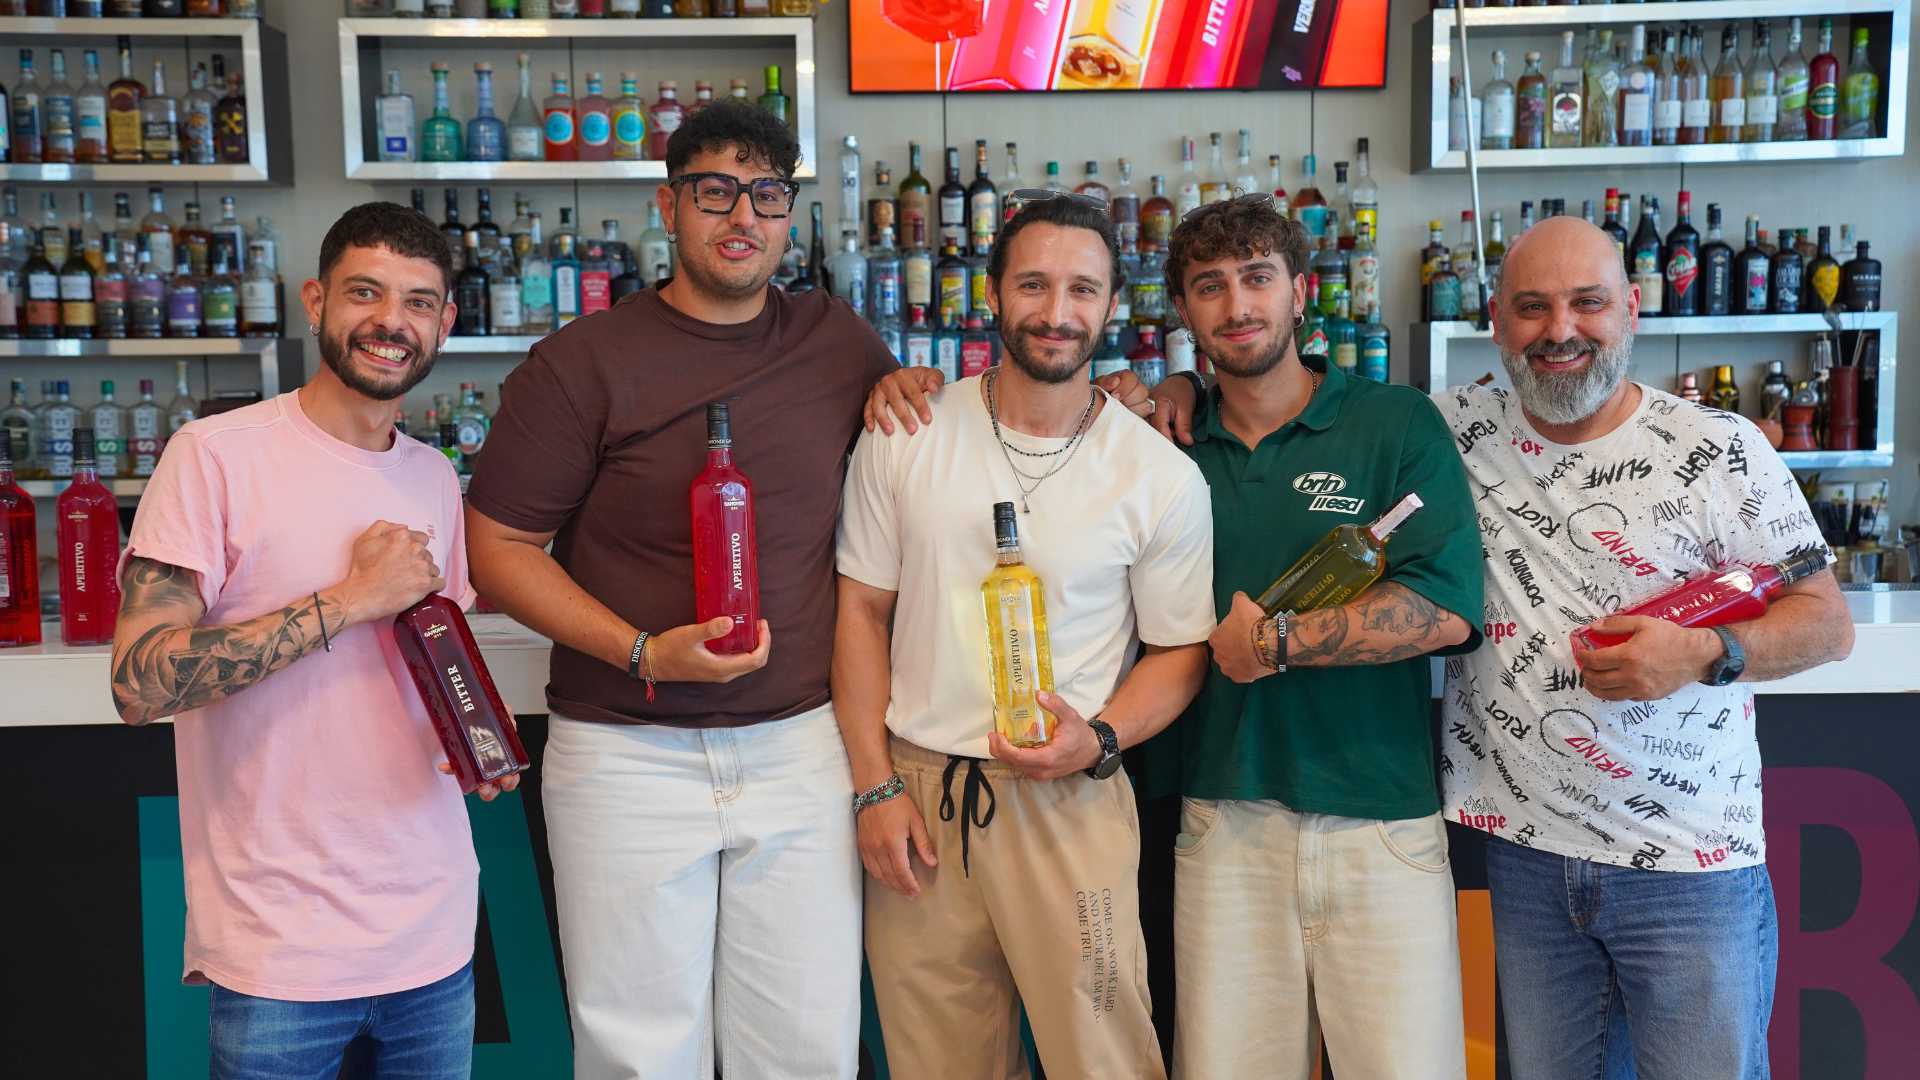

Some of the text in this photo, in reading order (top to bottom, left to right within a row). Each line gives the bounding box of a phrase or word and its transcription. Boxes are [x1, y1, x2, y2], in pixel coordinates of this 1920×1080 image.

[1673, 437, 1724, 488] FIGHT
[1652, 494, 1692, 527] ALIVE
[1737, 481, 1768, 531] ALIVE
[75, 541, 86, 593] APERITIVO
[731, 532, 744, 591] APERITIVO
[1591, 529, 1659, 578] GRIND
[1504, 548, 1545, 608] DOMINION
[1009, 628, 1024, 685] APERITIVO
[447, 664, 475, 713] BITTER
[1620, 700, 1658, 733] ALIVE
[1563, 736, 1633, 780] GRIND
[1641, 733, 1705, 761] THRASH
[1491, 748, 1530, 804] DOMINION
[1551, 778, 1611, 813] PUNK
[1648, 767, 1701, 797] METAL
[1458, 808, 1508, 838] hope
[1089, 890, 1100, 917] AND
[1102, 888, 1113, 926] COME
[1075, 891, 1092, 961] COME TRUE
[1092, 920, 1104, 954] YOUR
[1104, 985, 1116, 1012] HARD
